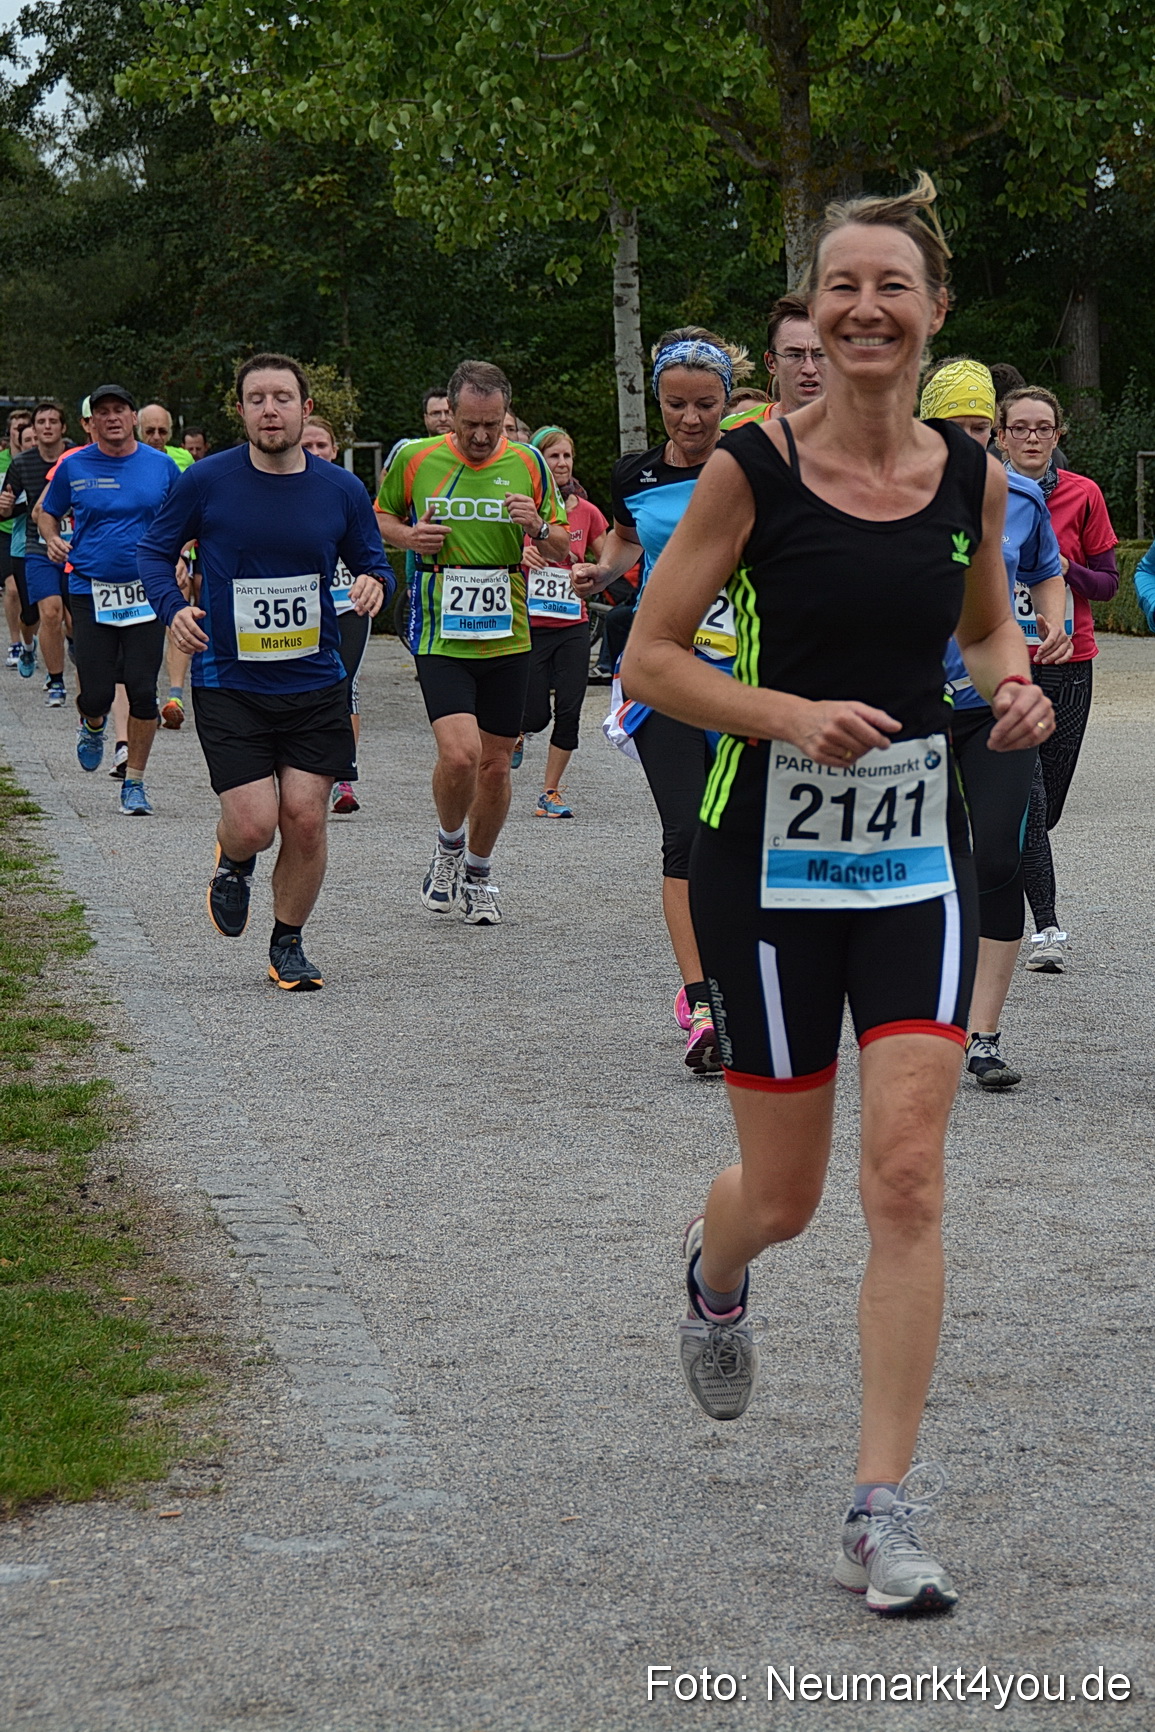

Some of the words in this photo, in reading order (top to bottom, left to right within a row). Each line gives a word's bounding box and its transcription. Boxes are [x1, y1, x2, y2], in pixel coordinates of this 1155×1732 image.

[446, 575, 469, 584] PARTL
[470, 576, 502, 584] Neumarkt
[100, 585, 146, 608] 2196
[236, 587, 265, 595] PARTL
[267, 584, 308, 595] Neumarkt
[450, 586, 507, 613] 2793
[543, 601, 568, 612] Sabine
[112, 608, 140, 620] Norbert
[253, 596, 307, 630] 356
[460, 618, 497, 630] Helmuth
[261, 636, 302, 650] Markus
[843, 759, 920, 778] Neumarkt
[786, 780, 925, 842] 2141
[807, 858, 907, 884] Manuela
